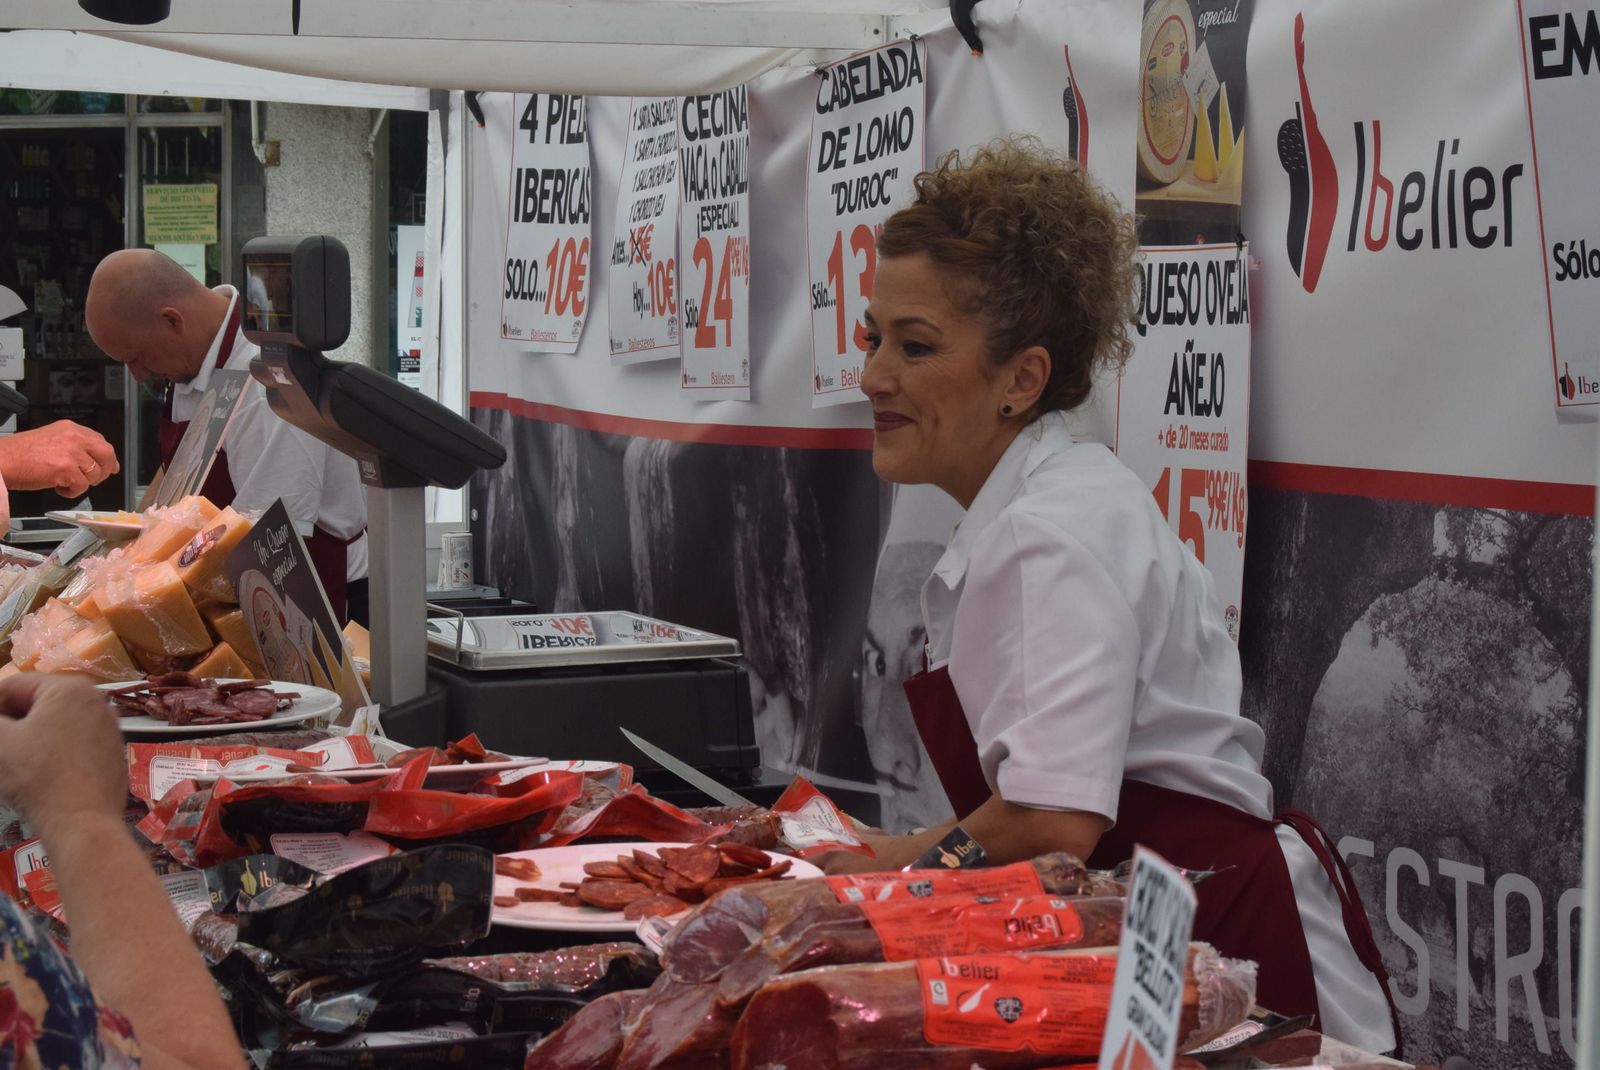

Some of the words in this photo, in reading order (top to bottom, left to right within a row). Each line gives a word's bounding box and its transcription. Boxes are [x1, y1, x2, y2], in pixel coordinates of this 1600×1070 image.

[1198, 1, 1239, 37] especial
[816, 41, 923, 115] CABEZADA
[520, 93, 538, 143] 4
[633, 108, 638, 131] 1
[682, 83, 748, 142] CECINA
[633, 140, 639, 162] 1
[817, 126, 850, 173] DE
[854, 106, 914, 164] LOMO
[514, 168, 590, 224] IBERICAS
[632, 170, 639, 192] 1
[681, 144, 709, 203] VACA
[831, 168, 899, 216] "DUROC"
[1347, 120, 1524, 252] Ibelier
[629, 201, 636, 224] 1
[544, 237, 589, 317] 10€
[647, 258, 676, 317] 10€
[1553, 240, 1600, 282] Sólo
[693, 235, 732, 348] 24
[1133, 262, 1200, 337] QUESO
[1206, 257, 1249, 327] OVEJA
[1164, 338, 1225, 418] AÑEJO
[1166, 424, 1177, 449] de
[1179, 425, 1189, 449] 20
[1190, 430, 1210, 451] meses
[1211, 427, 1229, 452] curado
[272, 542, 297, 591] especial
[938, 957, 1000, 980] Ibelier
